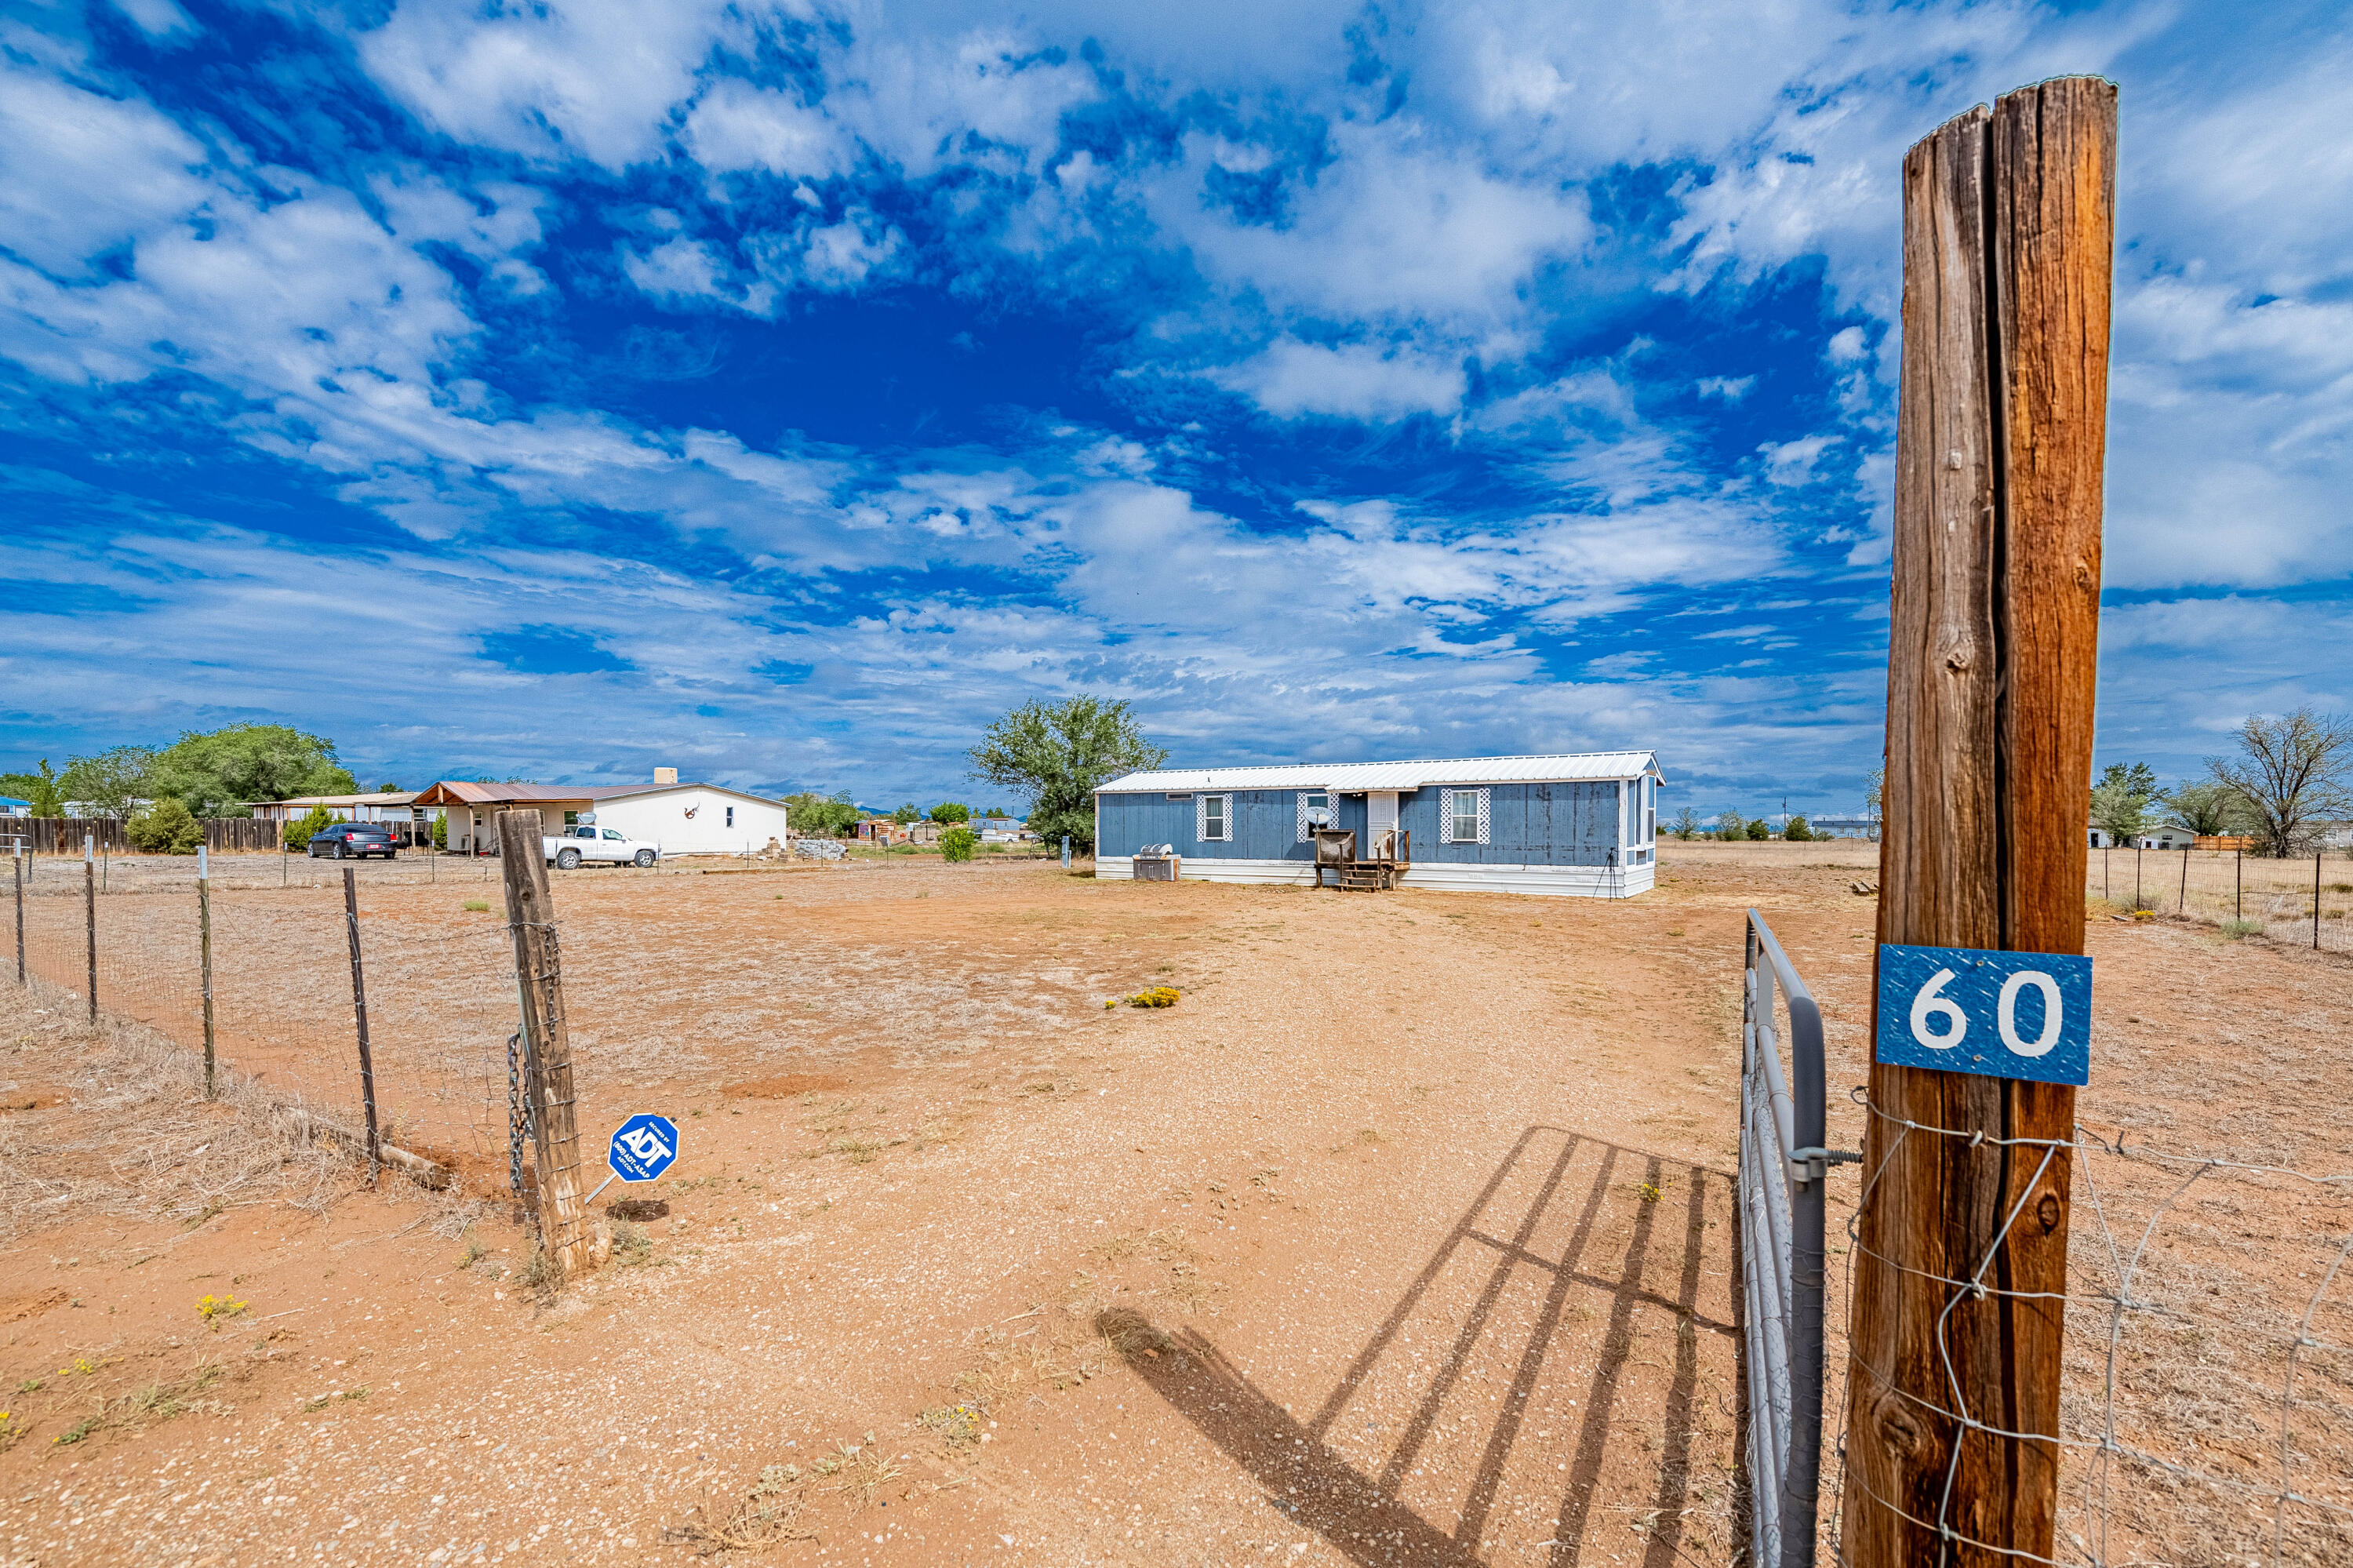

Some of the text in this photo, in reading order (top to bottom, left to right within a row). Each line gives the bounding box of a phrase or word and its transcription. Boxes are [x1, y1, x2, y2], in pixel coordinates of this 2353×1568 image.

[1910, 968, 2063, 1057] 60
[649, 1122, 665, 1138] SECURED
[619, 1126, 672, 1168] ADT
[624, 1154, 650, 1178] ADT-ASAP
